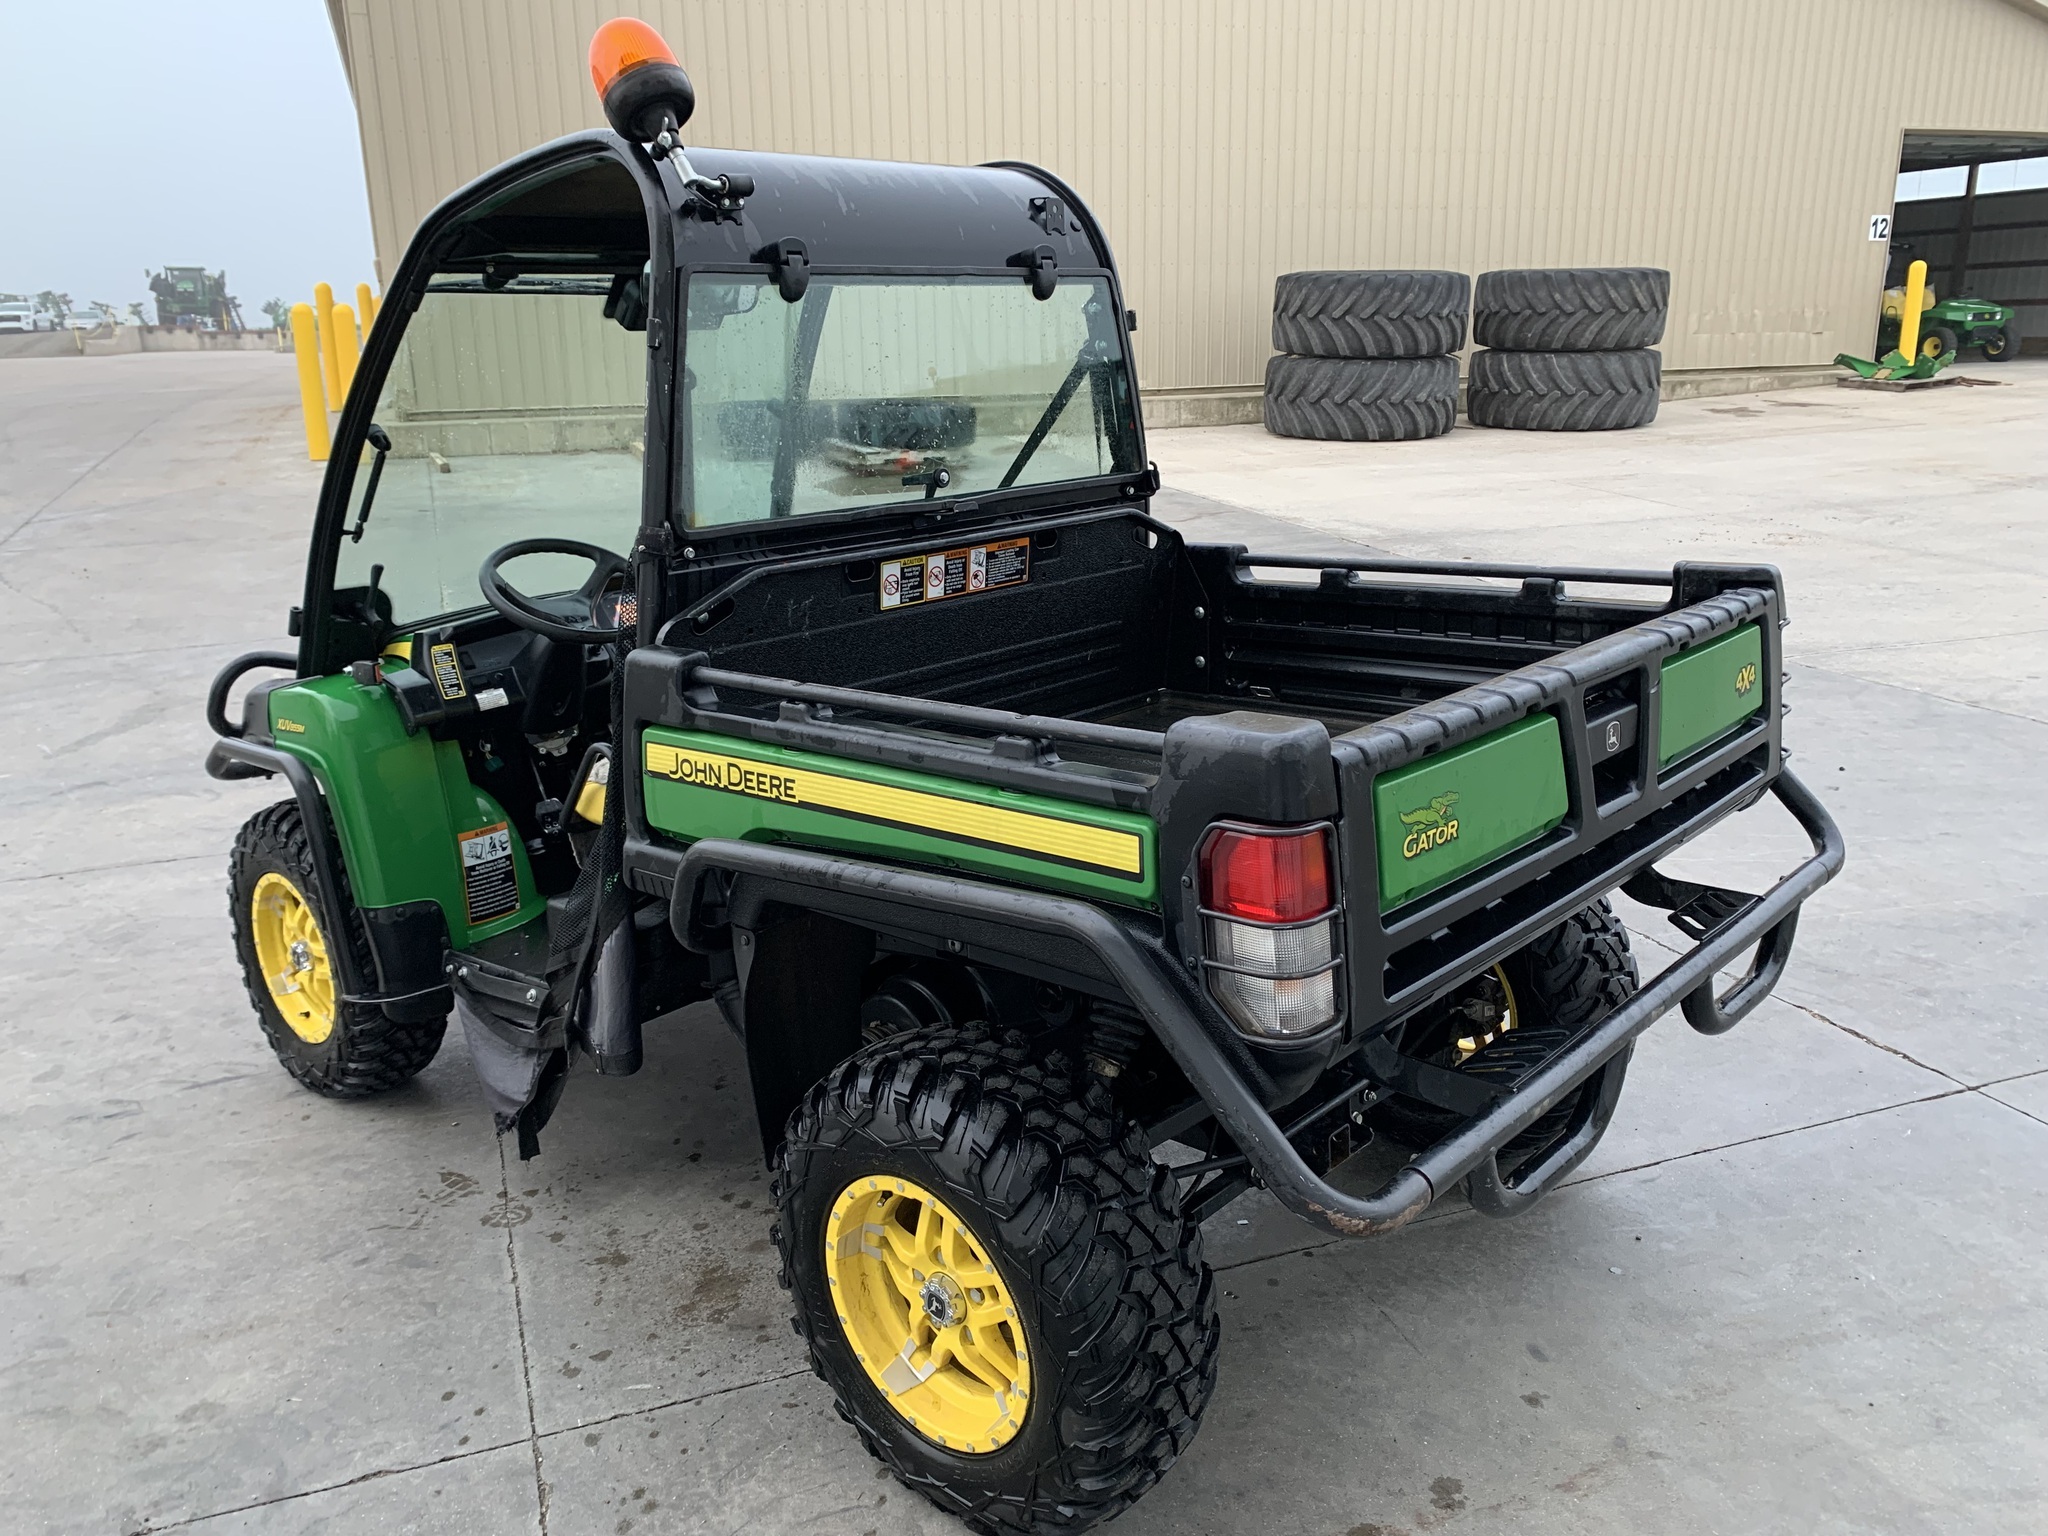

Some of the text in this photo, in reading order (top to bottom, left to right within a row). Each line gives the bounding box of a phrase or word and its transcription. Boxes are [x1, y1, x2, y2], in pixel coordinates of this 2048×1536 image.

[1871, 217, 1889, 239] 12
[906, 557, 924, 566] CAUTION
[669, 753, 797, 799] JOHN DEERE
[1403, 819, 1459, 859] GATOR
